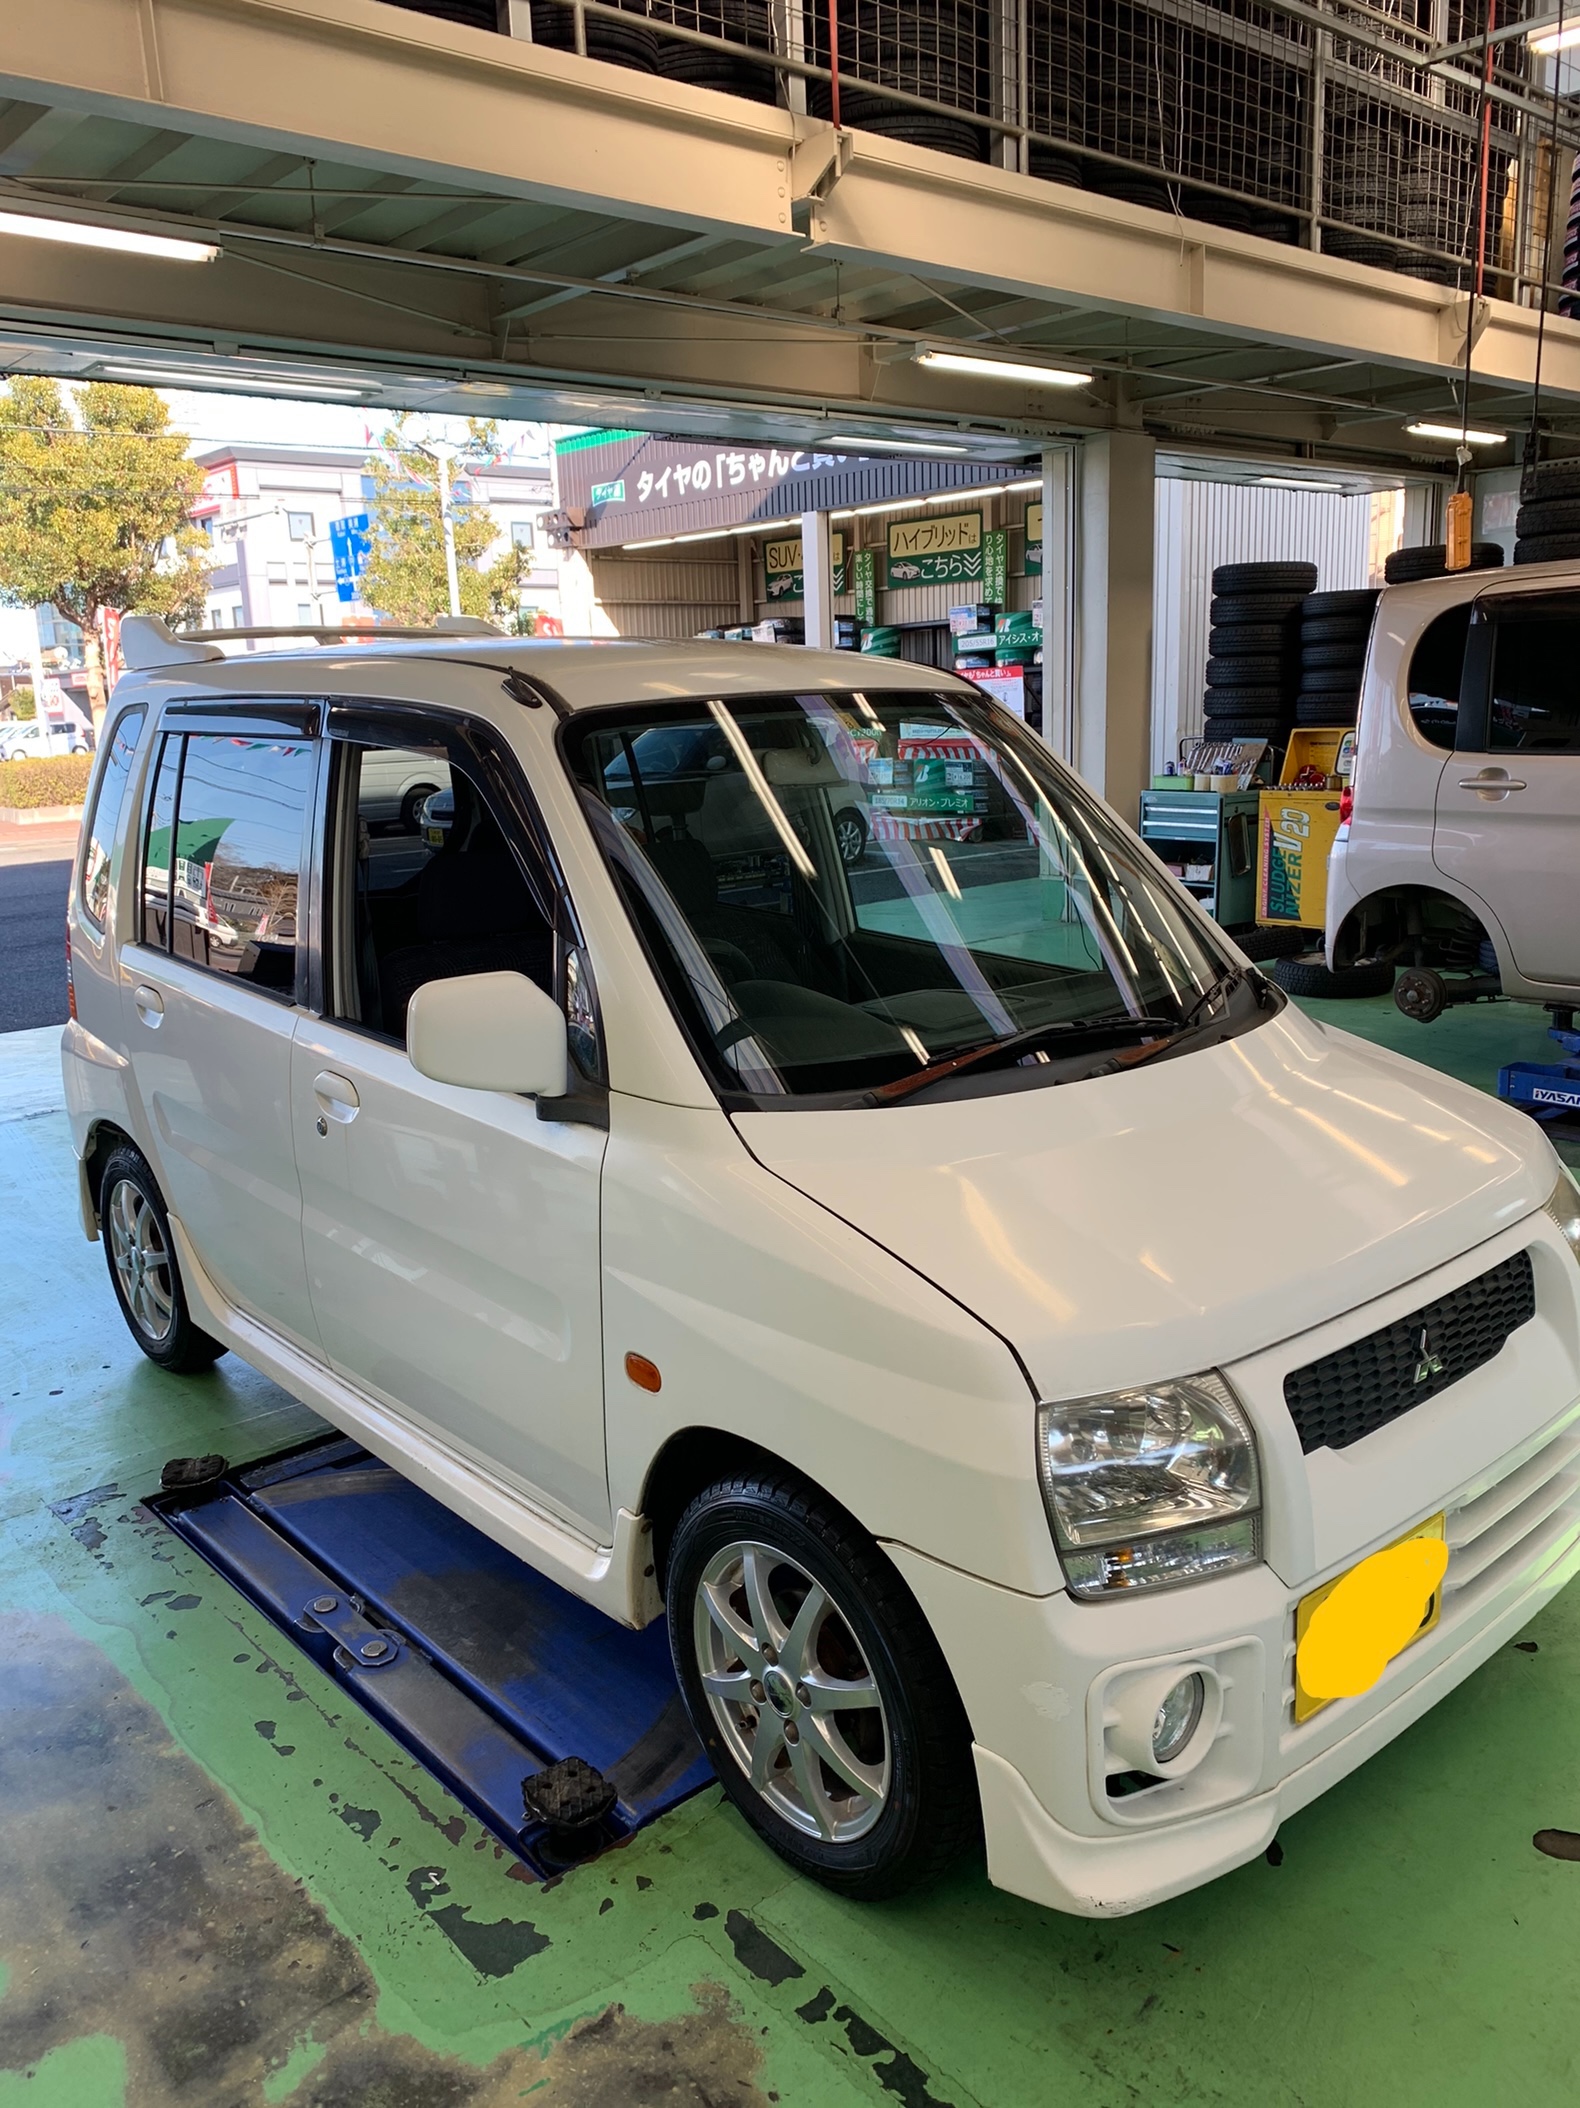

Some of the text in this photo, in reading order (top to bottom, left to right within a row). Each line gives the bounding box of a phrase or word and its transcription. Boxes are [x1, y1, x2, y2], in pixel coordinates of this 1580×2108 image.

[637, 449, 870, 501] タイヤの「ちゃんと買
[893, 522, 977, 552] ハイブリッドは
[921, 554, 963, 579] こちら
[910, 797, 969, 808] アリオン・プレミオ
[1270, 847, 1287, 913] SLUDGE
[1285, 853, 1303, 917] NIZER
